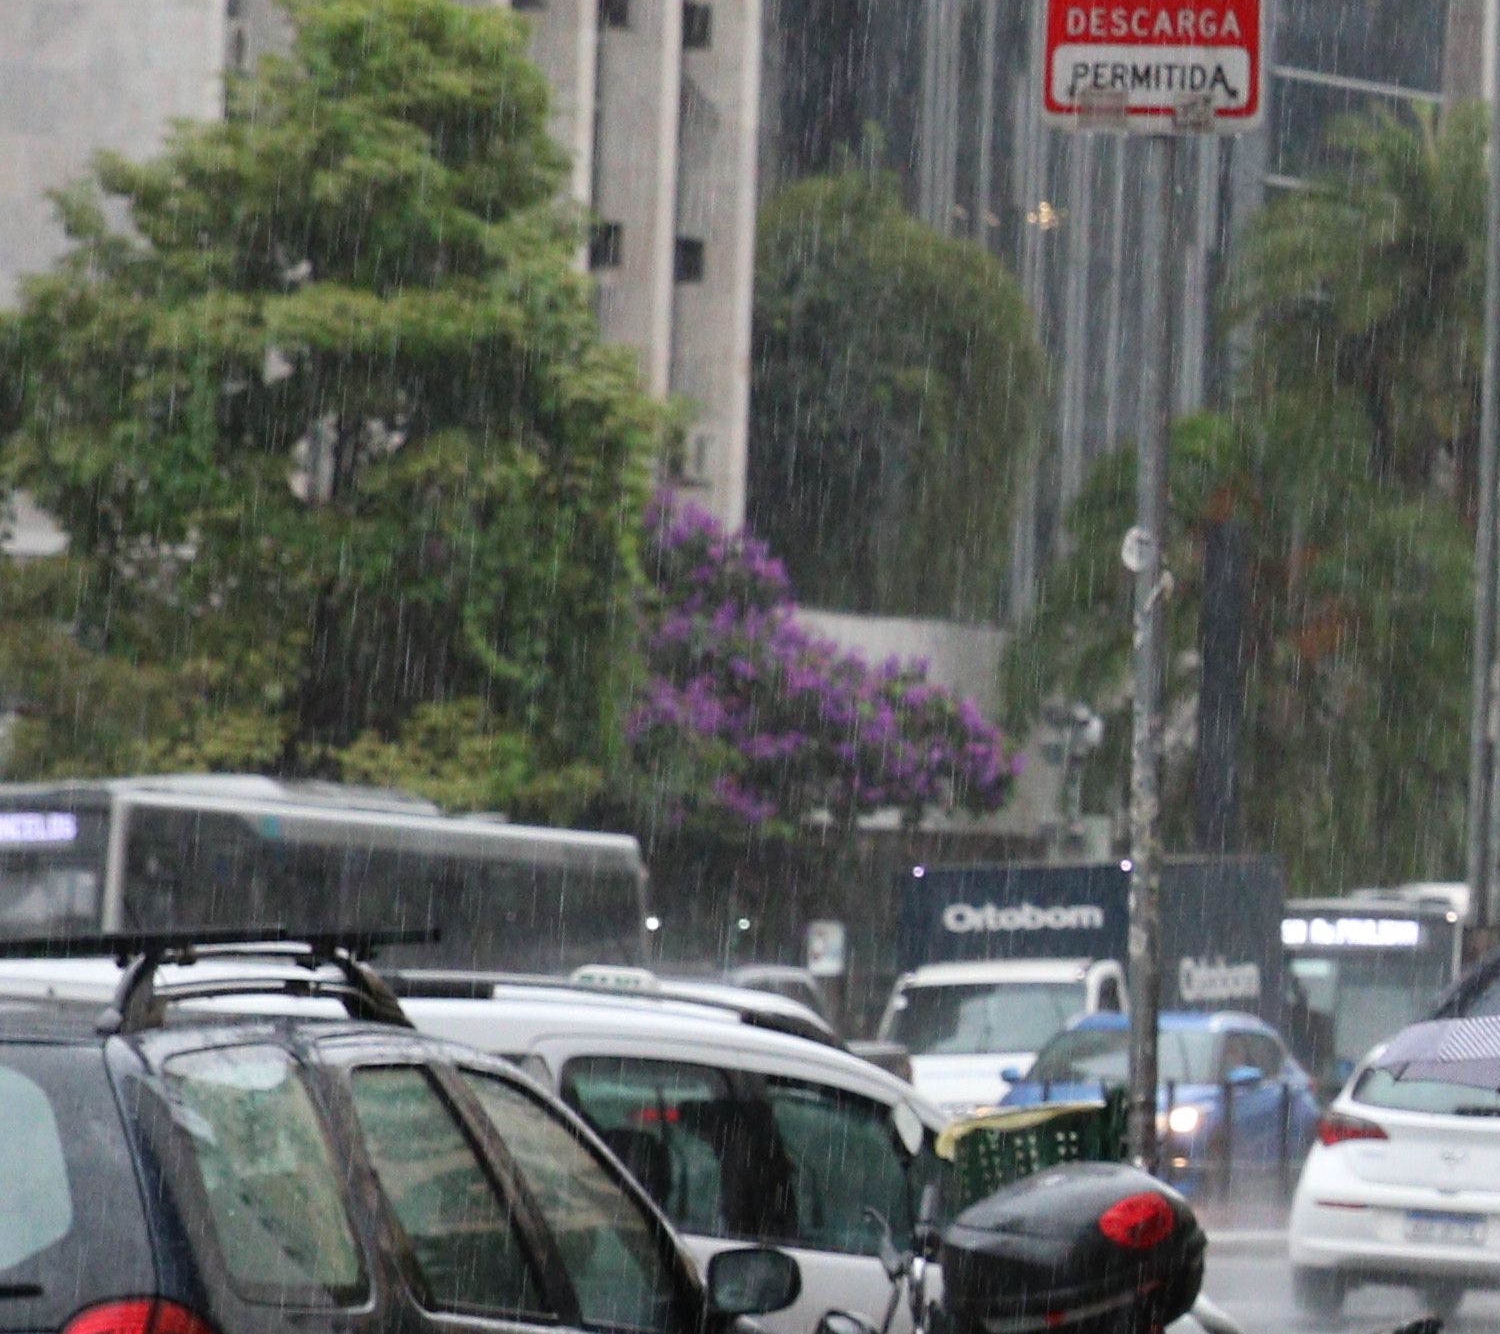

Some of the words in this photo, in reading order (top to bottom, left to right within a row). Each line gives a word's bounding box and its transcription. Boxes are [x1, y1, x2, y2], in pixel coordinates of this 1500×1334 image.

[1065, 9, 1242, 38] DESCARGA
[1069, 61, 1238, 98] PERMITIDA
[943, 902, 1105, 933] Ortobom
